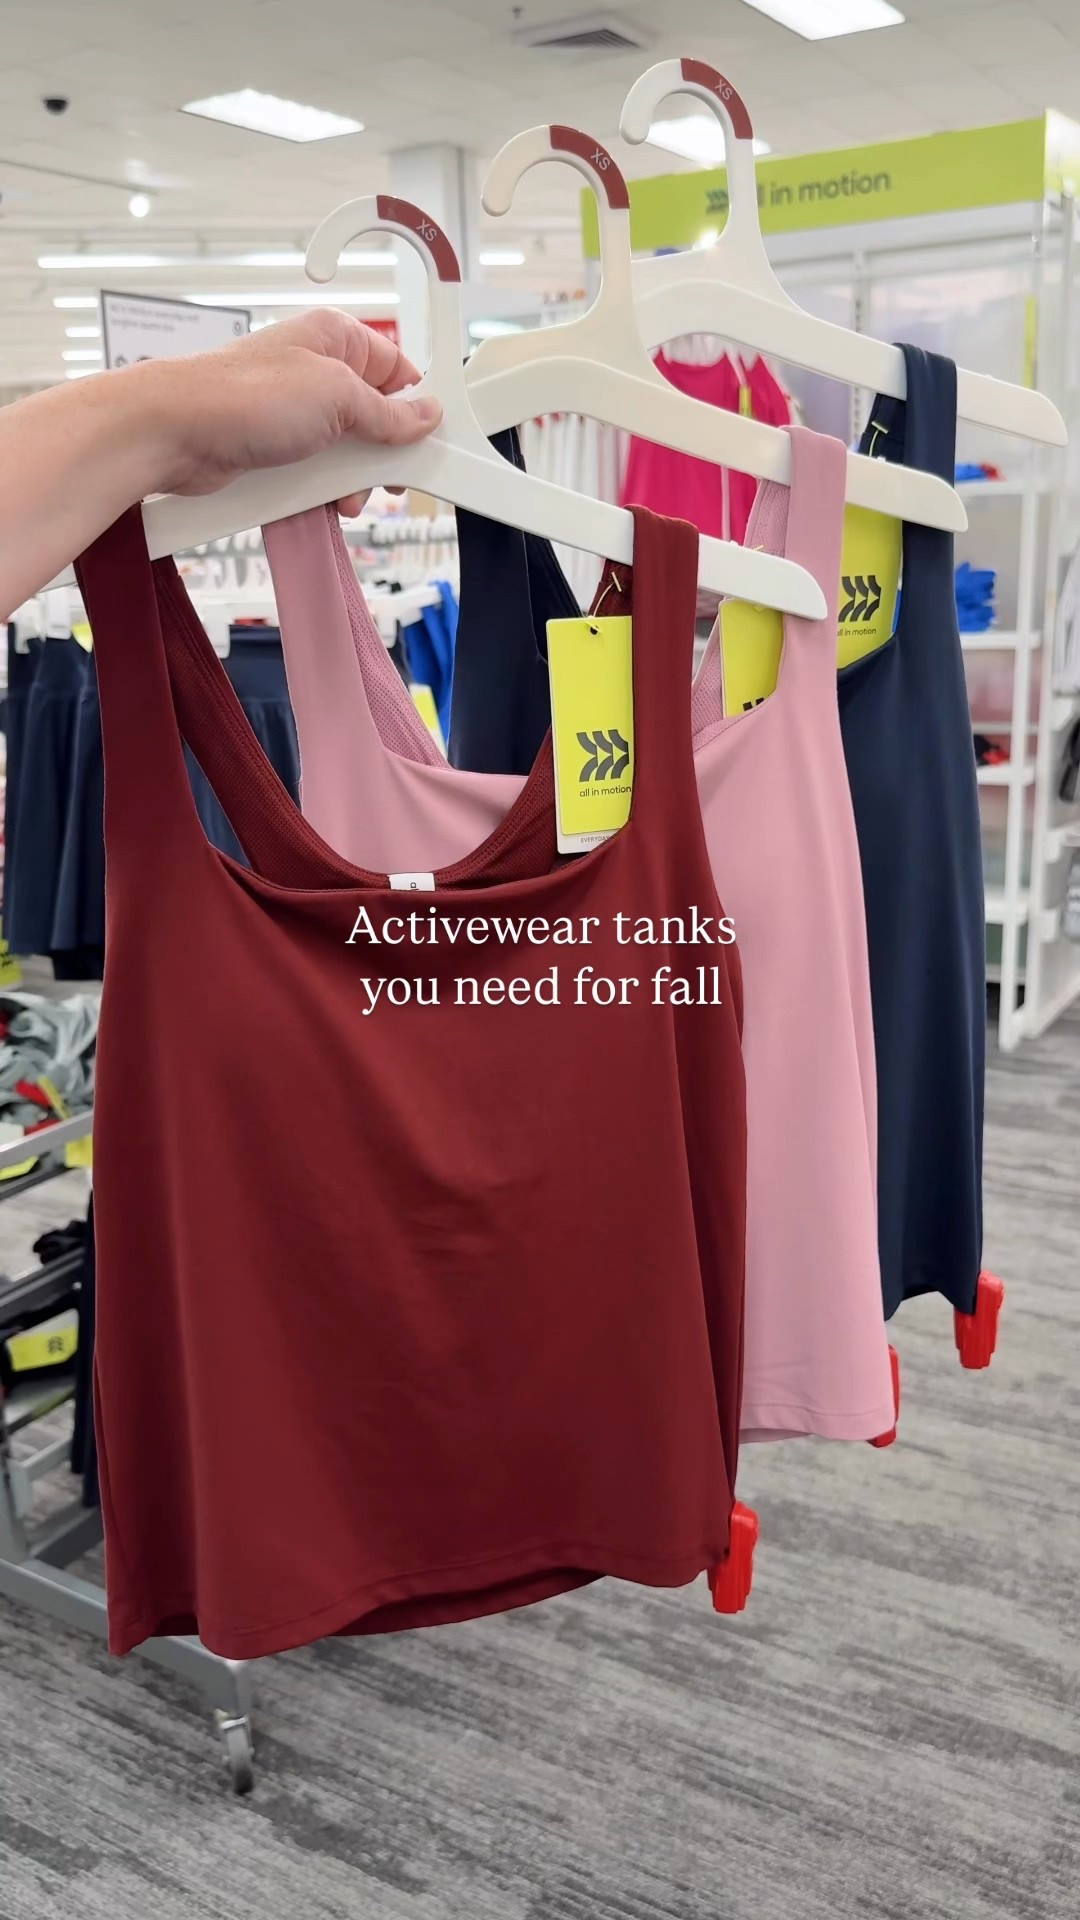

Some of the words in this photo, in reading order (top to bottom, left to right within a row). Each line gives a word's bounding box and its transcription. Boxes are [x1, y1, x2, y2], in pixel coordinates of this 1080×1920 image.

[715, 79, 733, 101] XS
[590, 148, 611, 171] XS
[770, 181, 794, 207] in
[798, 170, 892, 203] motion
[415, 218, 438, 242] XS
[851, 627, 877, 636] motion
[579, 788, 590, 798] all
[591, 787, 600, 797] in
[601, 784, 632, 796] motion
[580, 835, 610, 844] EVERYDAY
